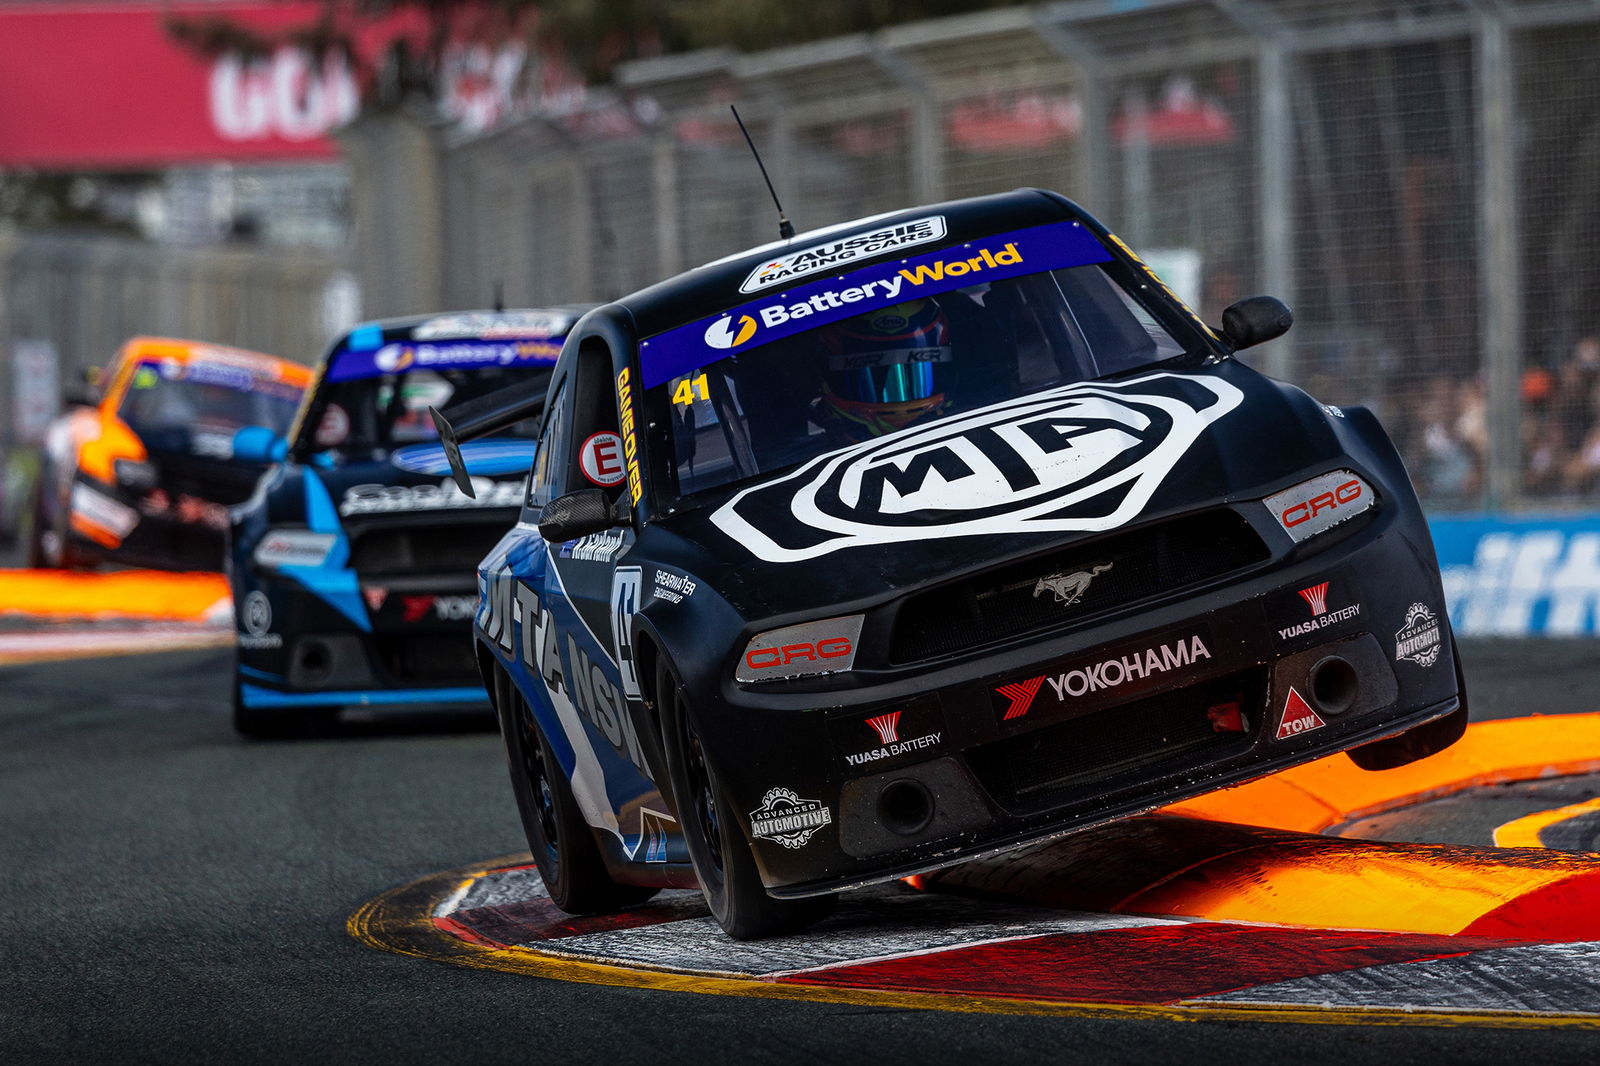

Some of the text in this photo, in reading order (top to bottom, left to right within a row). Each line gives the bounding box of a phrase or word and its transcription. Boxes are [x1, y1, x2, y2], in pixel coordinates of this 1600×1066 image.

[759, 230, 933, 285] RACING CARS
[791, 220, 931, 267] AUSSIE
[672, 373, 711, 406] 41
[593, 441, 621, 476] E
[853, 402, 1150, 514] MTA
[1281, 479, 1362, 528] CRG
[654, 569, 697, 597] SHEARWATER
[1278, 603, 1361, 640] YUASA BATTERY
[745, 636, 853, 669] CRG
[1046, 635, 1212, 702] YOKOHAMA
[1282, 714, 1316, 735] TOW
[845, 731, 941, 766] YUASA BATTERY
[753, 809, 829, 836] AUTOMOTIVE
[756, 803, 817, 821] ADVANCED
